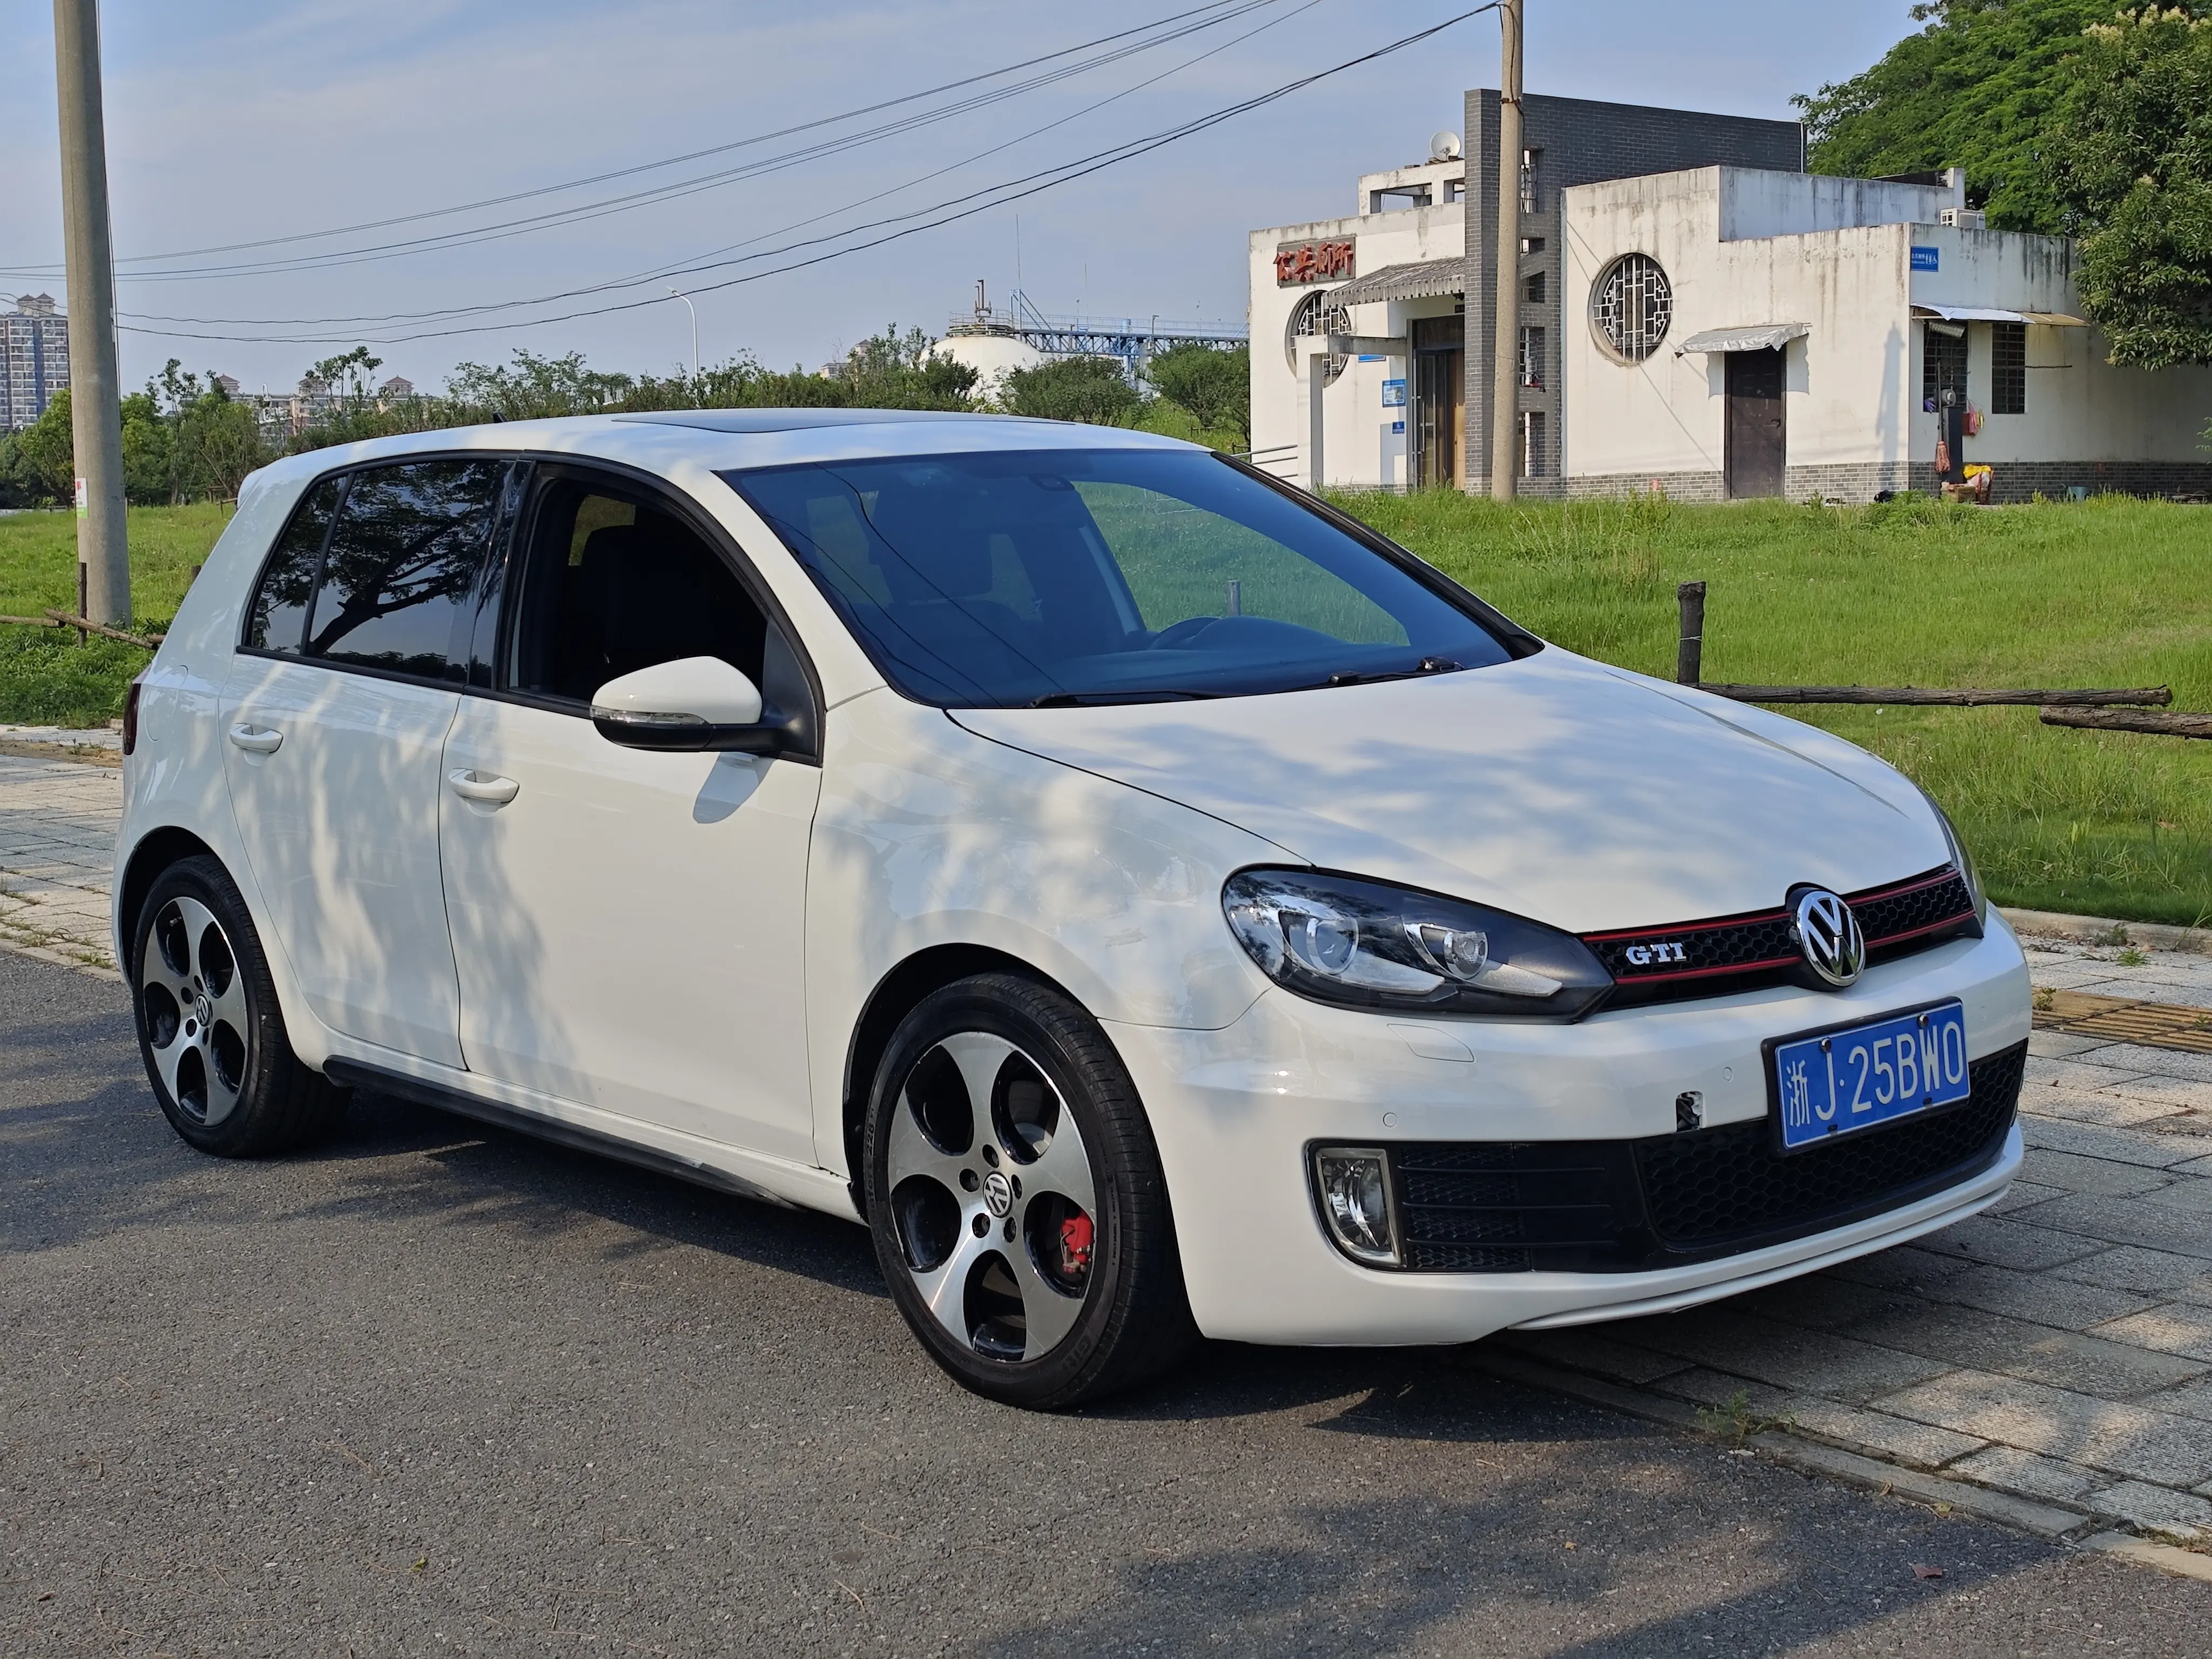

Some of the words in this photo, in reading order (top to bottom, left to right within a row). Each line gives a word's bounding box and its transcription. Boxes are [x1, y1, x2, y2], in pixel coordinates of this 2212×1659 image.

[1273, 241, 1354, 282] 公共厕所
[1626, 942, 1687, 965] GTI
